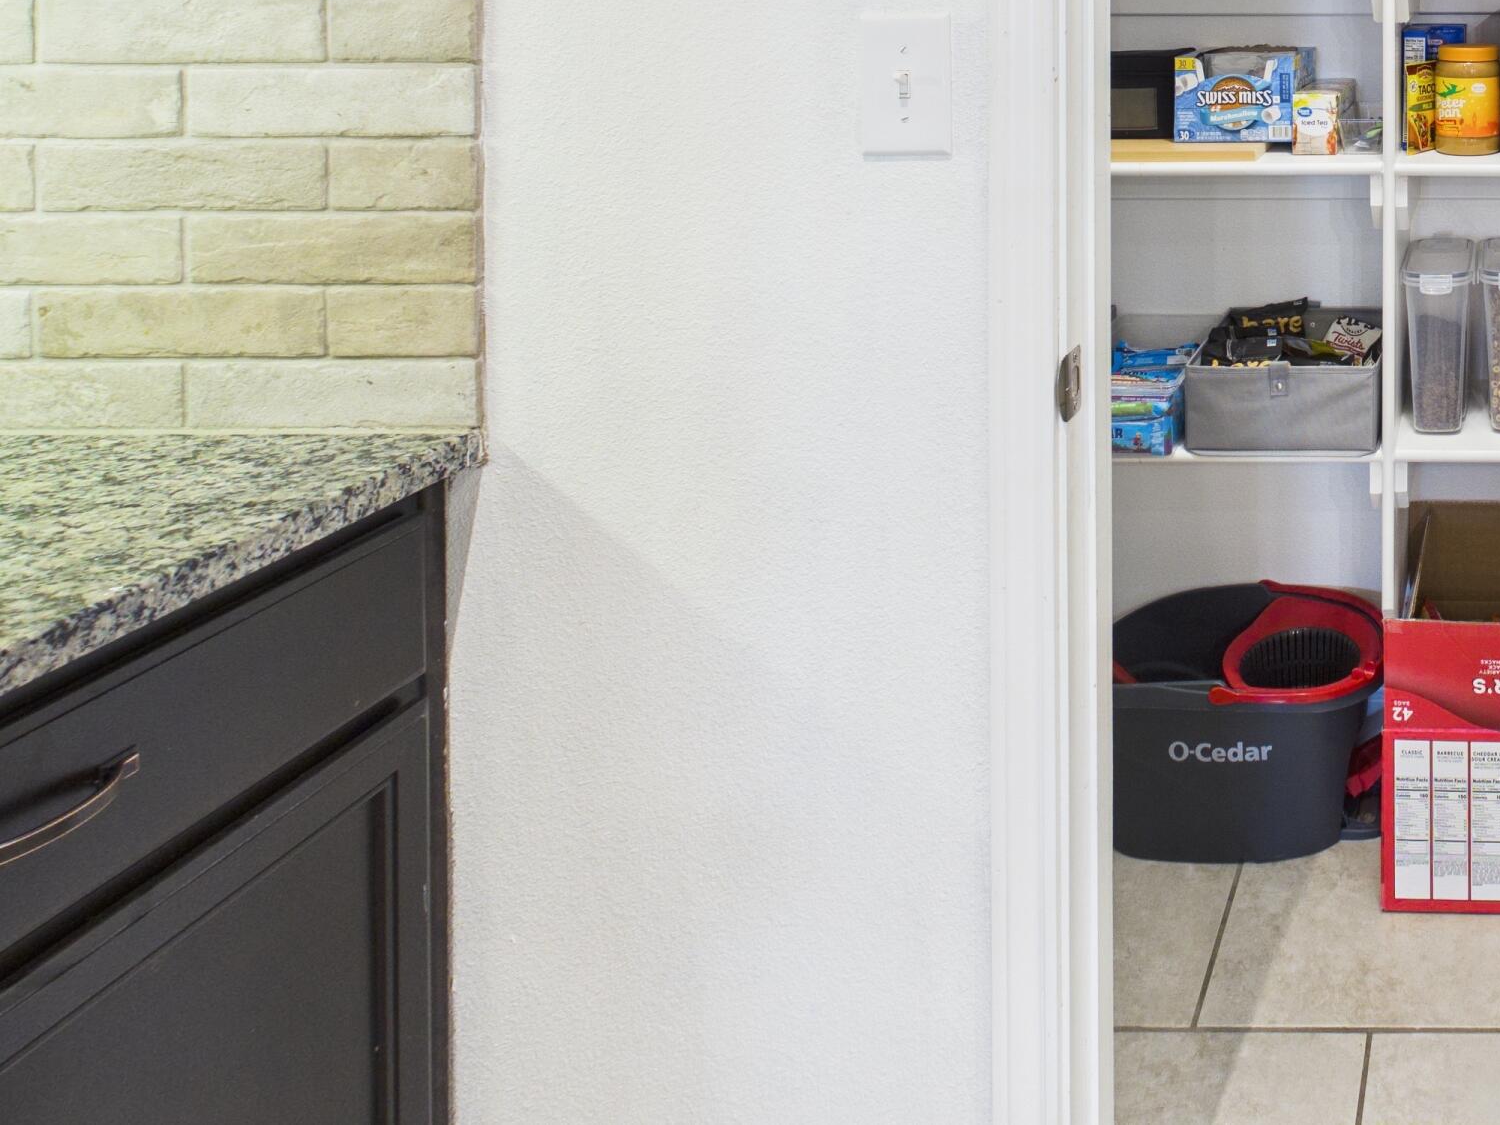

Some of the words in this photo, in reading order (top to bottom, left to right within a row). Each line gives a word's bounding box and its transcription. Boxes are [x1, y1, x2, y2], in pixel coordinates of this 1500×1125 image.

[1179, 131, 1189, 140] 30
[1392, 706, 1413, 722] 42
[1168, 741, 1273, 763] O-Cedar
